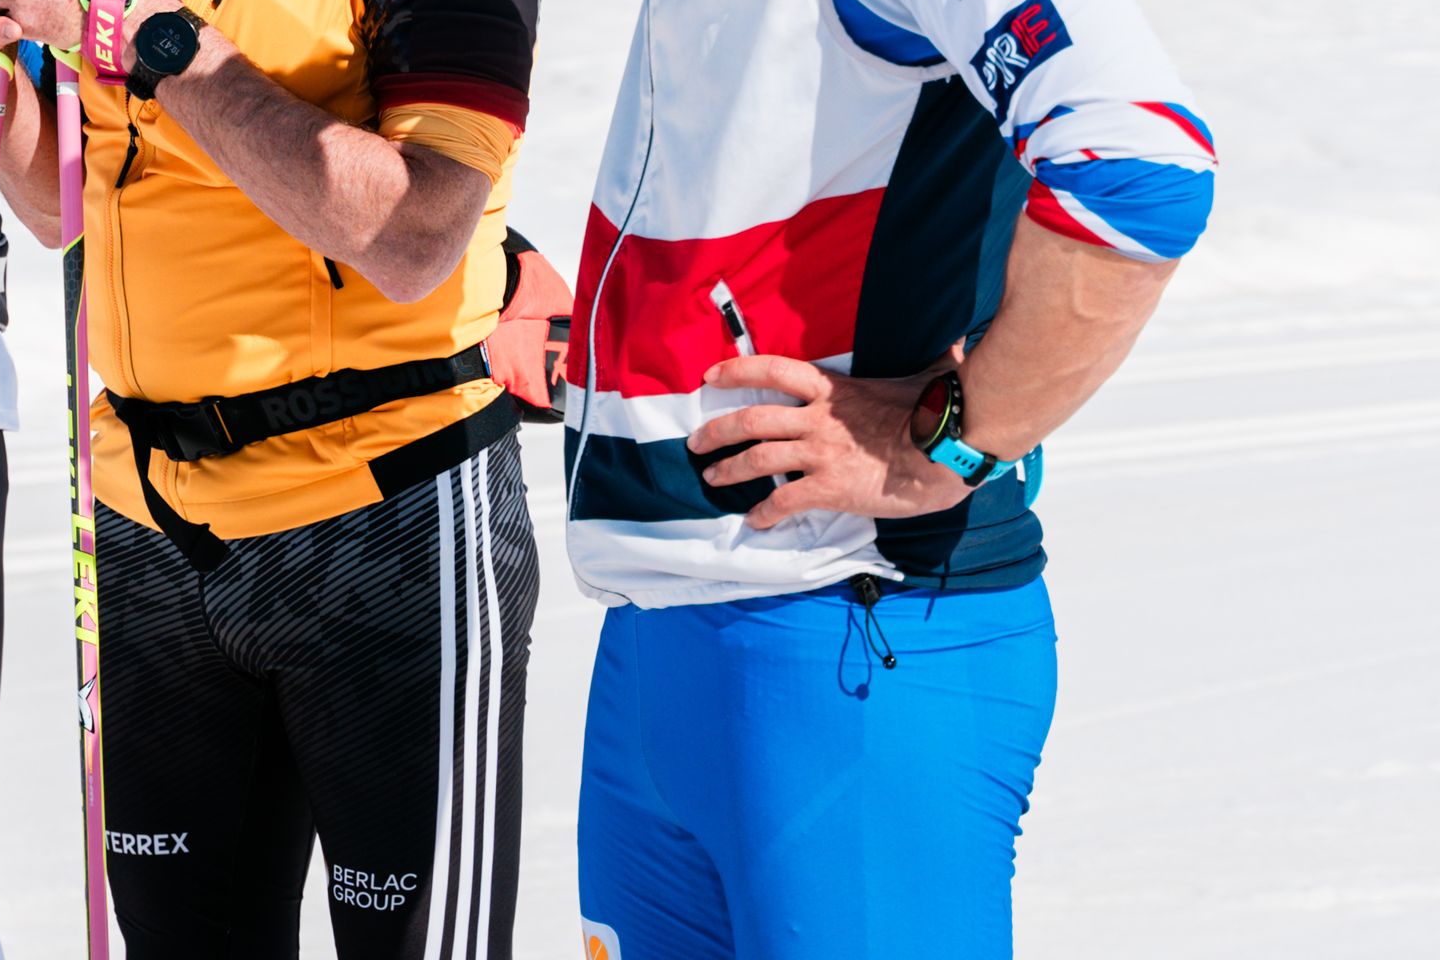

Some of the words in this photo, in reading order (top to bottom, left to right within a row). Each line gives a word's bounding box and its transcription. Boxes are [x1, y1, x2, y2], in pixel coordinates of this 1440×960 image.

[98, 9, 116, 73] LEKI
[71, 512, 97, 646] LEKI
[105, 830, 189, 855] TERREX
[333, 864, 418, 891] BERLAC
[333, 884, 406, 911] GROUP
